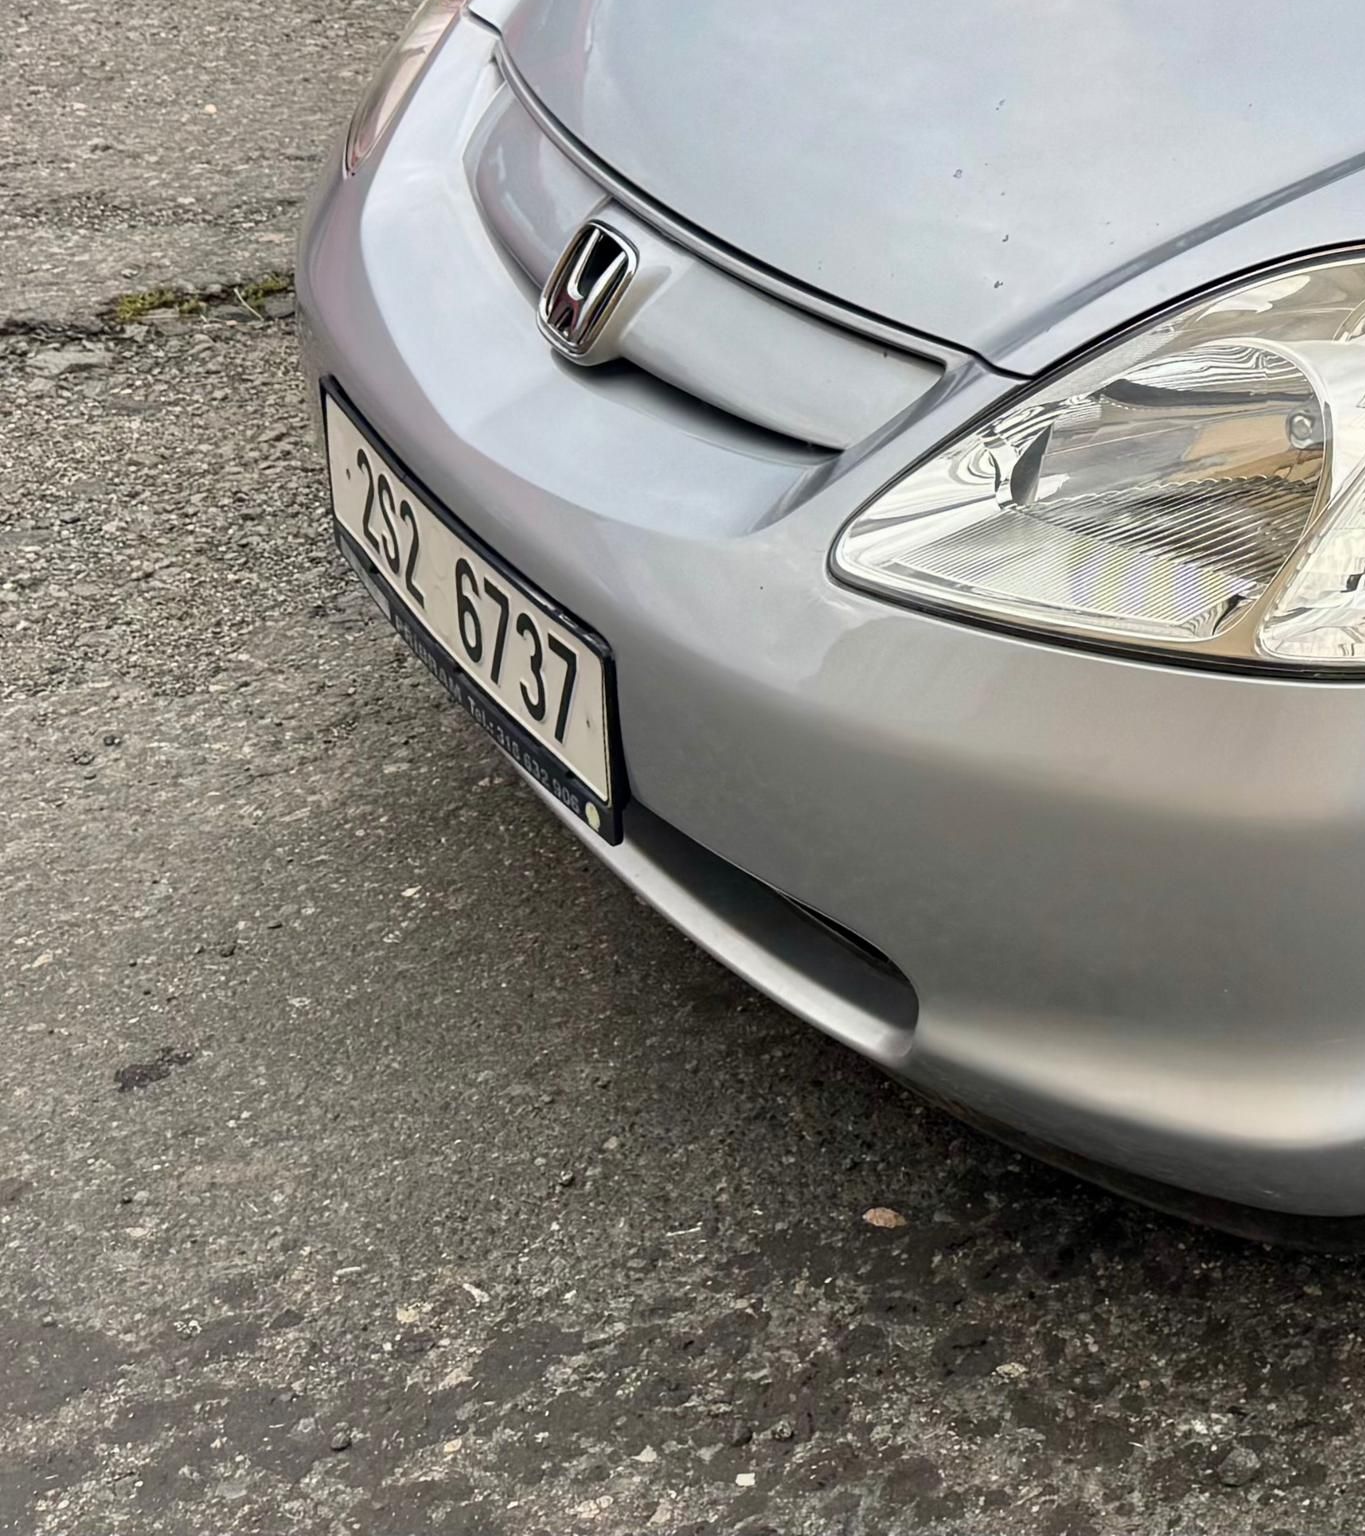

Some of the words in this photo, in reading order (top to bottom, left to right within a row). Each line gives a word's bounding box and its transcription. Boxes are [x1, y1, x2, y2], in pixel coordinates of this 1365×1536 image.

[356, 448, 426, 610] 2S2
[455, 557, 578, 744] 6737
[523, 753, 550, 785] 632
[552, 777, 581, 814] 906
